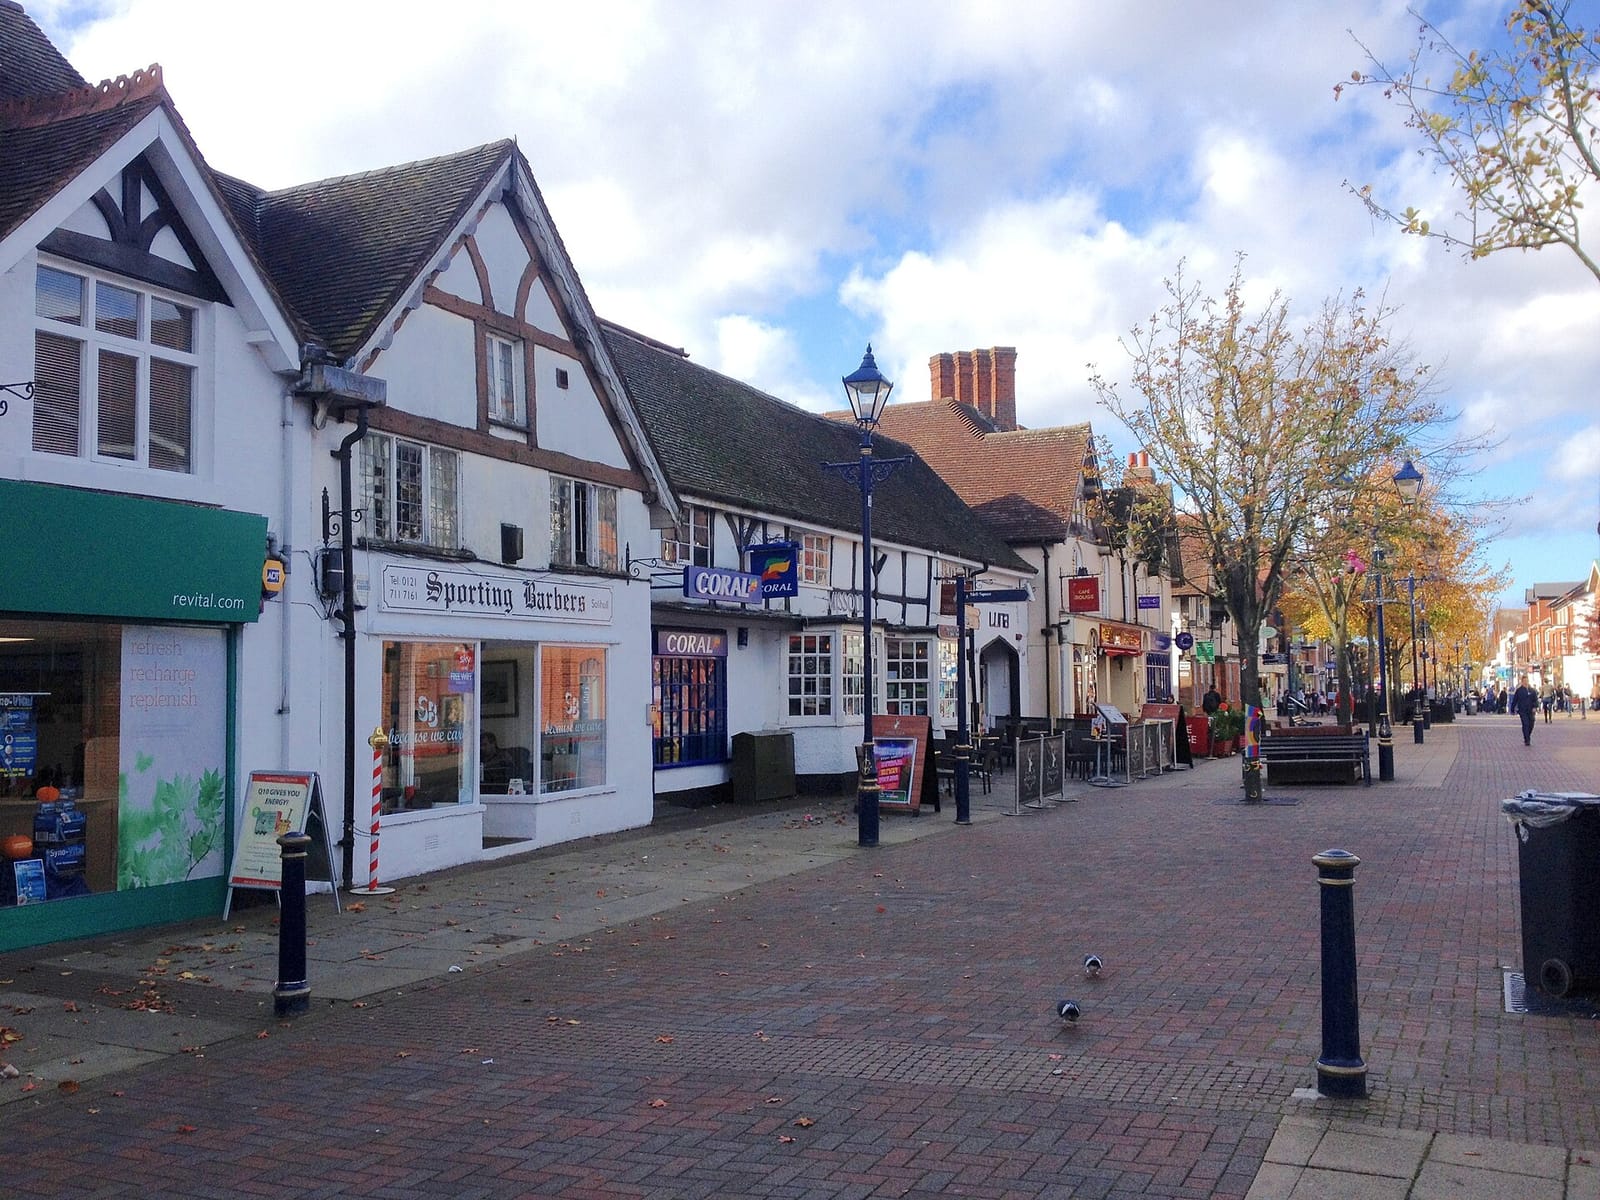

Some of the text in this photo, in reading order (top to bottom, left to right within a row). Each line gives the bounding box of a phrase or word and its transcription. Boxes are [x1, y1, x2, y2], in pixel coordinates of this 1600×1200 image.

[268, 571, 280, 581] ADT
[402, 576, 417, 587] 0121
[695, 571, 750, 598] CORAL
[390, 589, 418, 600] 711 7161
[425, 571, 586, 614] Sporting Barbers
[761, 582, 793, 593] ORAL
[172, 592, 245, 609] revital.com
[130, 635, 183, 656] refresh
[666, 634, 714, 653] CORAL
[130, 662, 196, 684] recharge
[129, 687, 198, 712] replenish
[430, 731, 446, 741] we
[269, 788, 287, 797] GIVES
